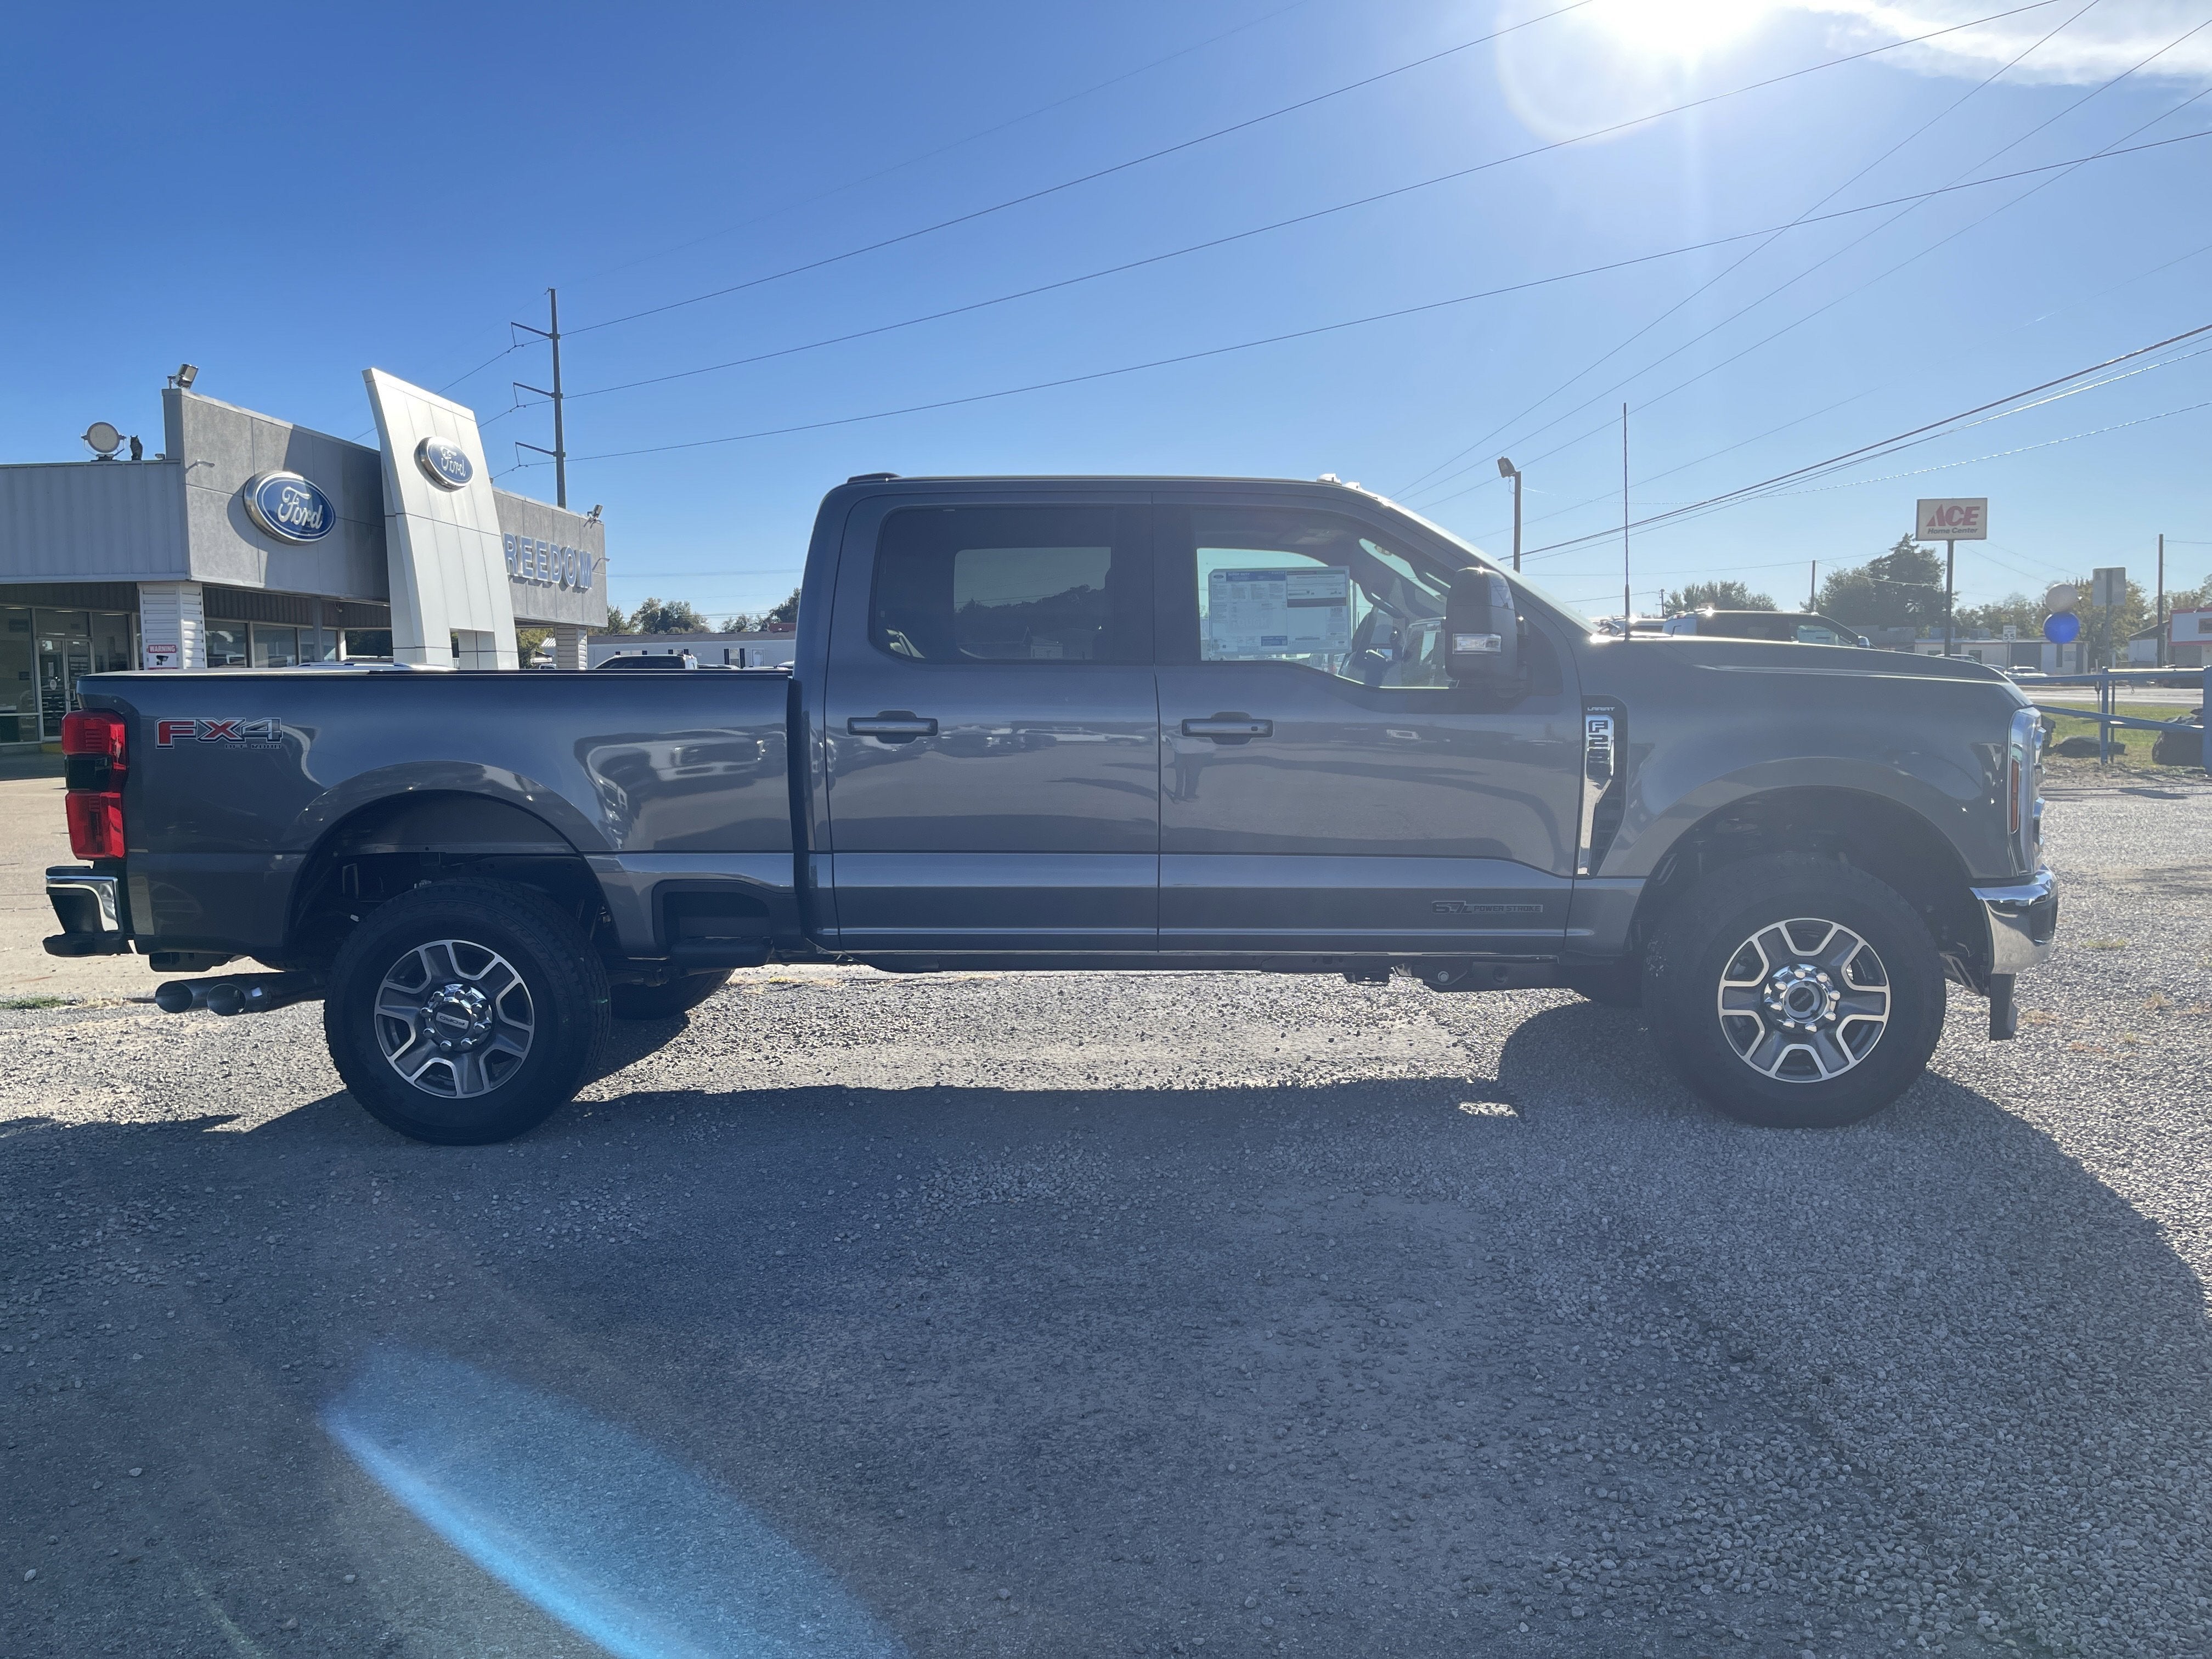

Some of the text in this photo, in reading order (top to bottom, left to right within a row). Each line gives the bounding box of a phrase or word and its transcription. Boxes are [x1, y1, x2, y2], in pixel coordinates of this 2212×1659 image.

[441, 446, 466, 477] Ford
[277, 486, 323, 529] Ford
[1926, 504, 1980, 527] ACE
[503, 531, 592, 590] REEDOM
[155, 718, 283, 749] FX4
[439, 1015, 465, 1026] FORD
